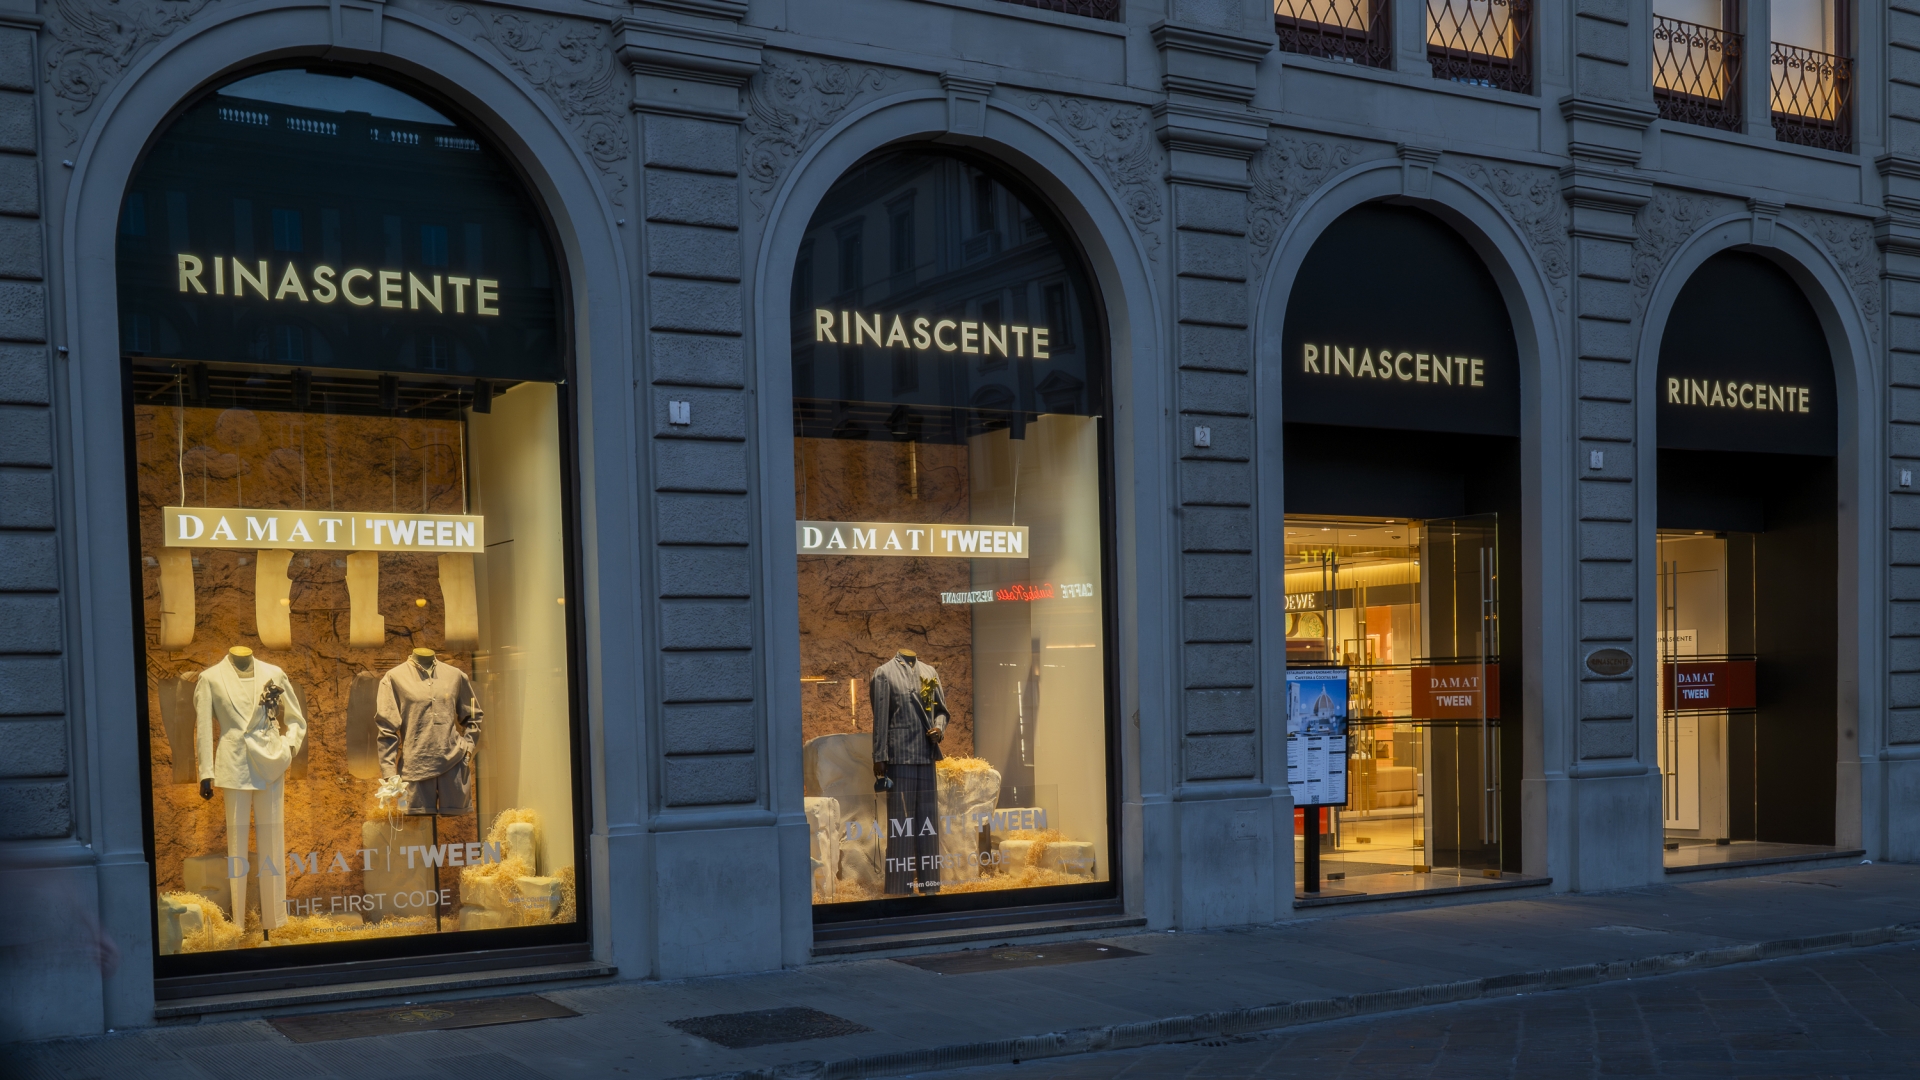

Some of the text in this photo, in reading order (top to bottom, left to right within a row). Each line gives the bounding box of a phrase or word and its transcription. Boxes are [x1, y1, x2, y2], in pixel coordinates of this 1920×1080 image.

[177, 252, 500, 317] RINASCENTE
[814, 308, 1050, 360] RINASCENTE
[1302, 342, 1485, 388] RINASCENTE
[1666, 376, 1811, 414] RINASCENTE
[1199, 430, 1207, 443] 2
[177, 513, 344, 545] DAMAT
[802, 525, 925, 552] DAMAT
[1590, 657, 1629, 666] RINASCENTE
[1430, 676, 1479, 689] DAMAT
[1678, 672, 1715, 684] DAMAT
[844, 814, 957, 841] DAMAT
[224, 847, 379, 880] DAMAT
[885, 849, 1011, 873] THE FIRST CODE
[282, 888, 452, 916] THE FIRST CODE
